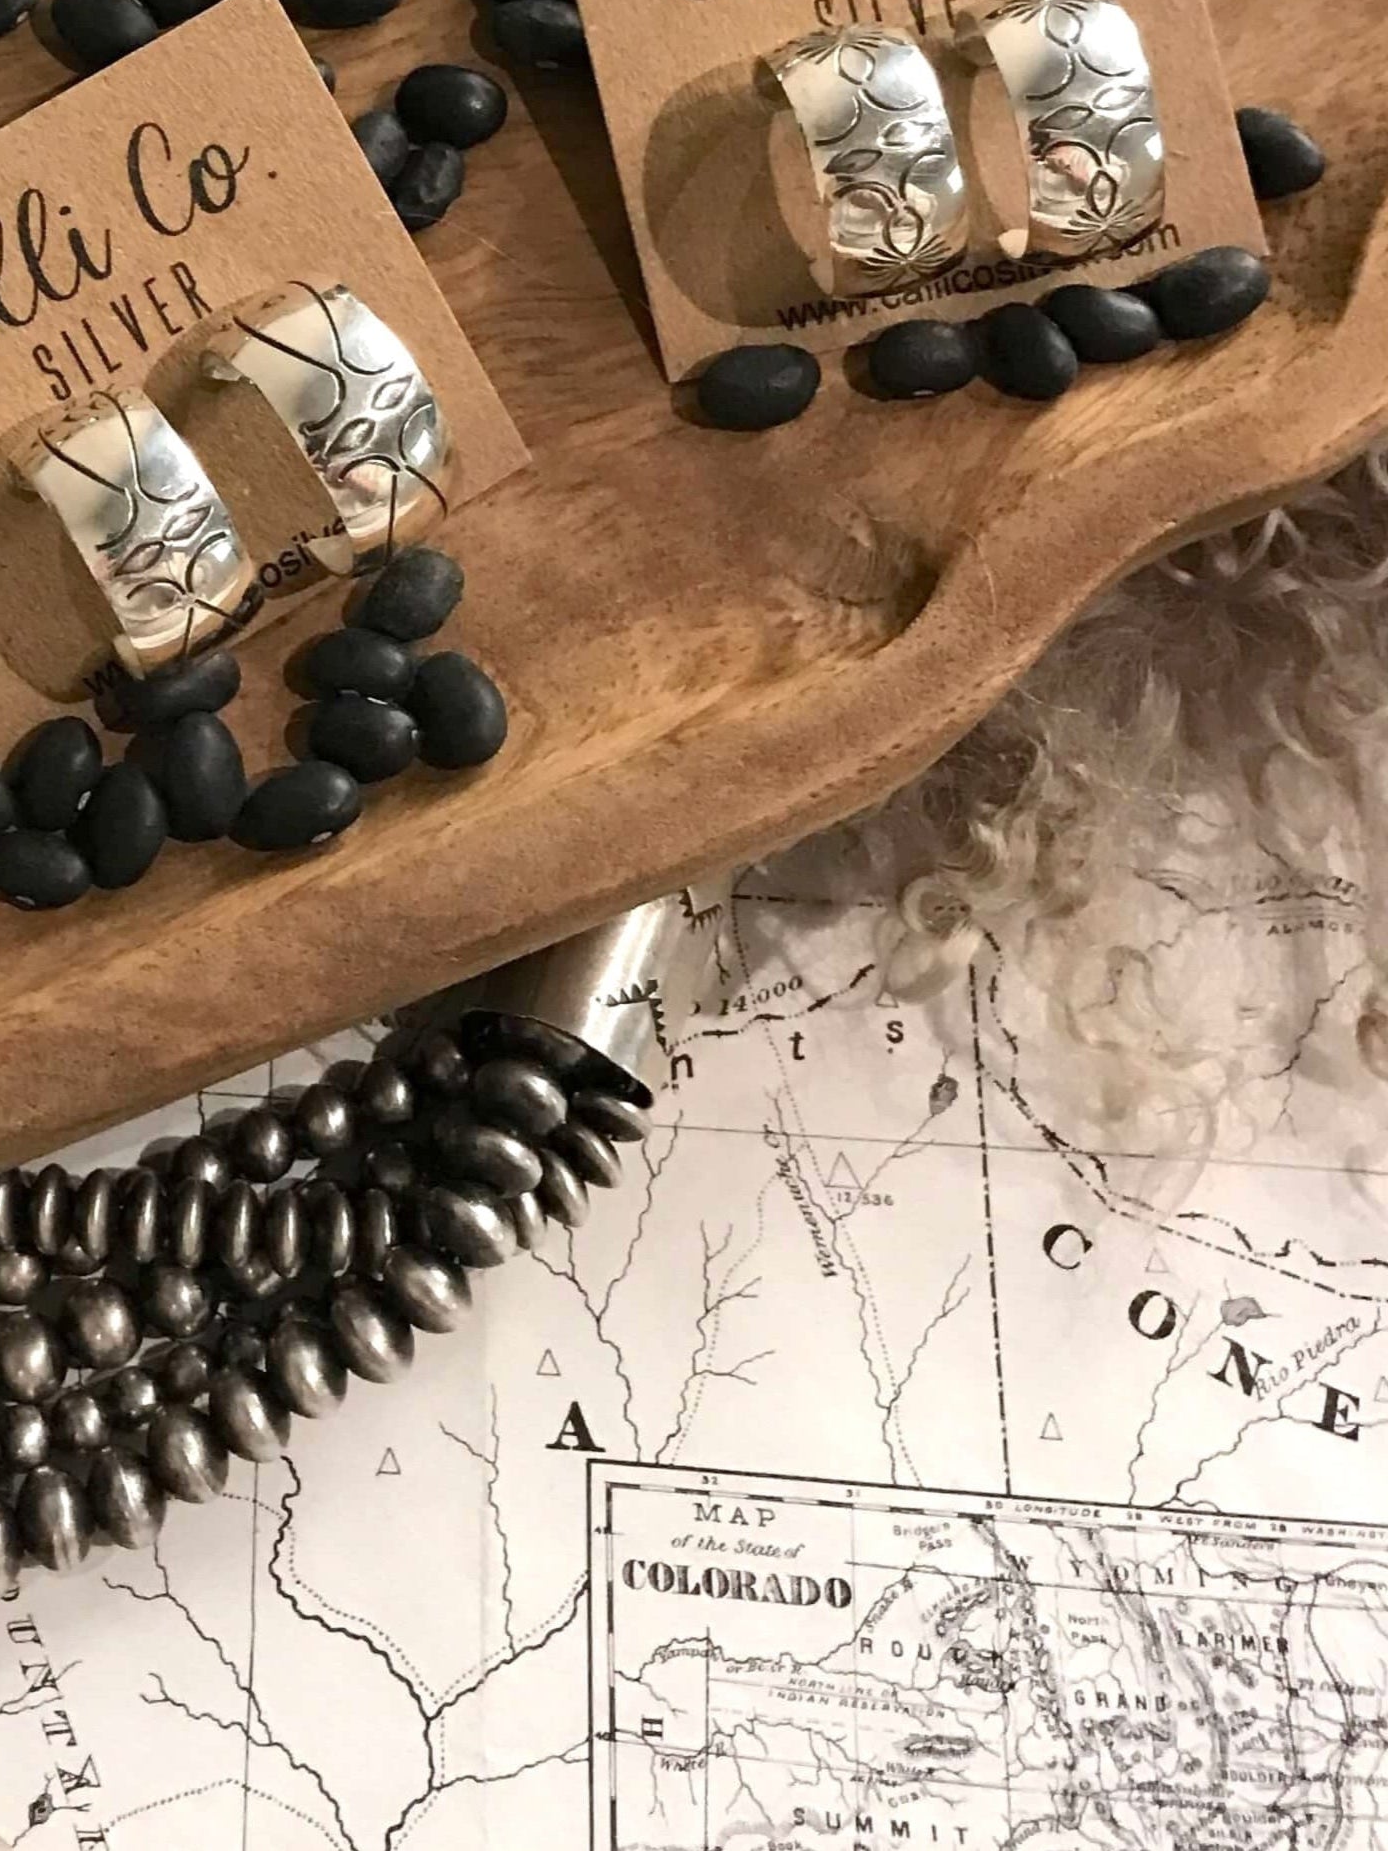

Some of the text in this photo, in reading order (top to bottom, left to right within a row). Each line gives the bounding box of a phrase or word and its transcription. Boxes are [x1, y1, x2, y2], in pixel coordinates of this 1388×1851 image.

[127, 121, 279, 237] Co.
[32, 260, 212, 401] SILVER
[1291, 1315, 1362, 1372] Piedra
[692, 1502, 776, 1527] MAP
[670, 1535, 693, 1548] of
[697, 1536, 727, 1552] the
[621, 1559, 853, 1609] COLORADO
[792, 1808, 971, 1846] SUMMIT
